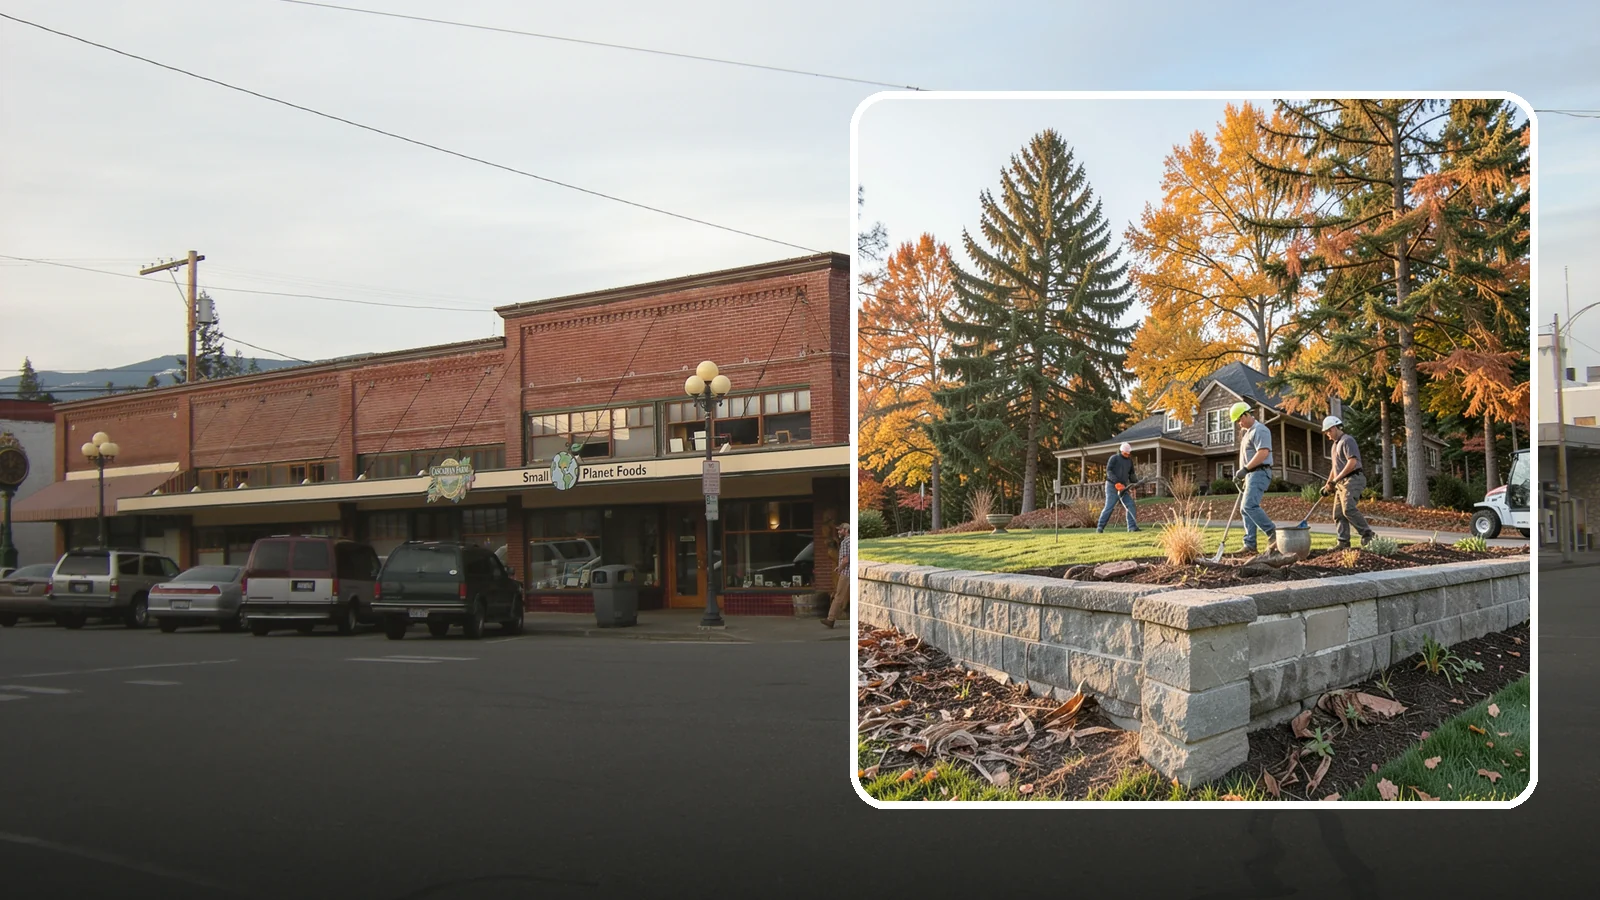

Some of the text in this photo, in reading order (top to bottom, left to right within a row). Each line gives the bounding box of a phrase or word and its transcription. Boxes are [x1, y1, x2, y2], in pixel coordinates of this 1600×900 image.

[431, 466, 469, 476] CASCADIAN FARM
[523, 465, 647, 482] Small Planet Foods
